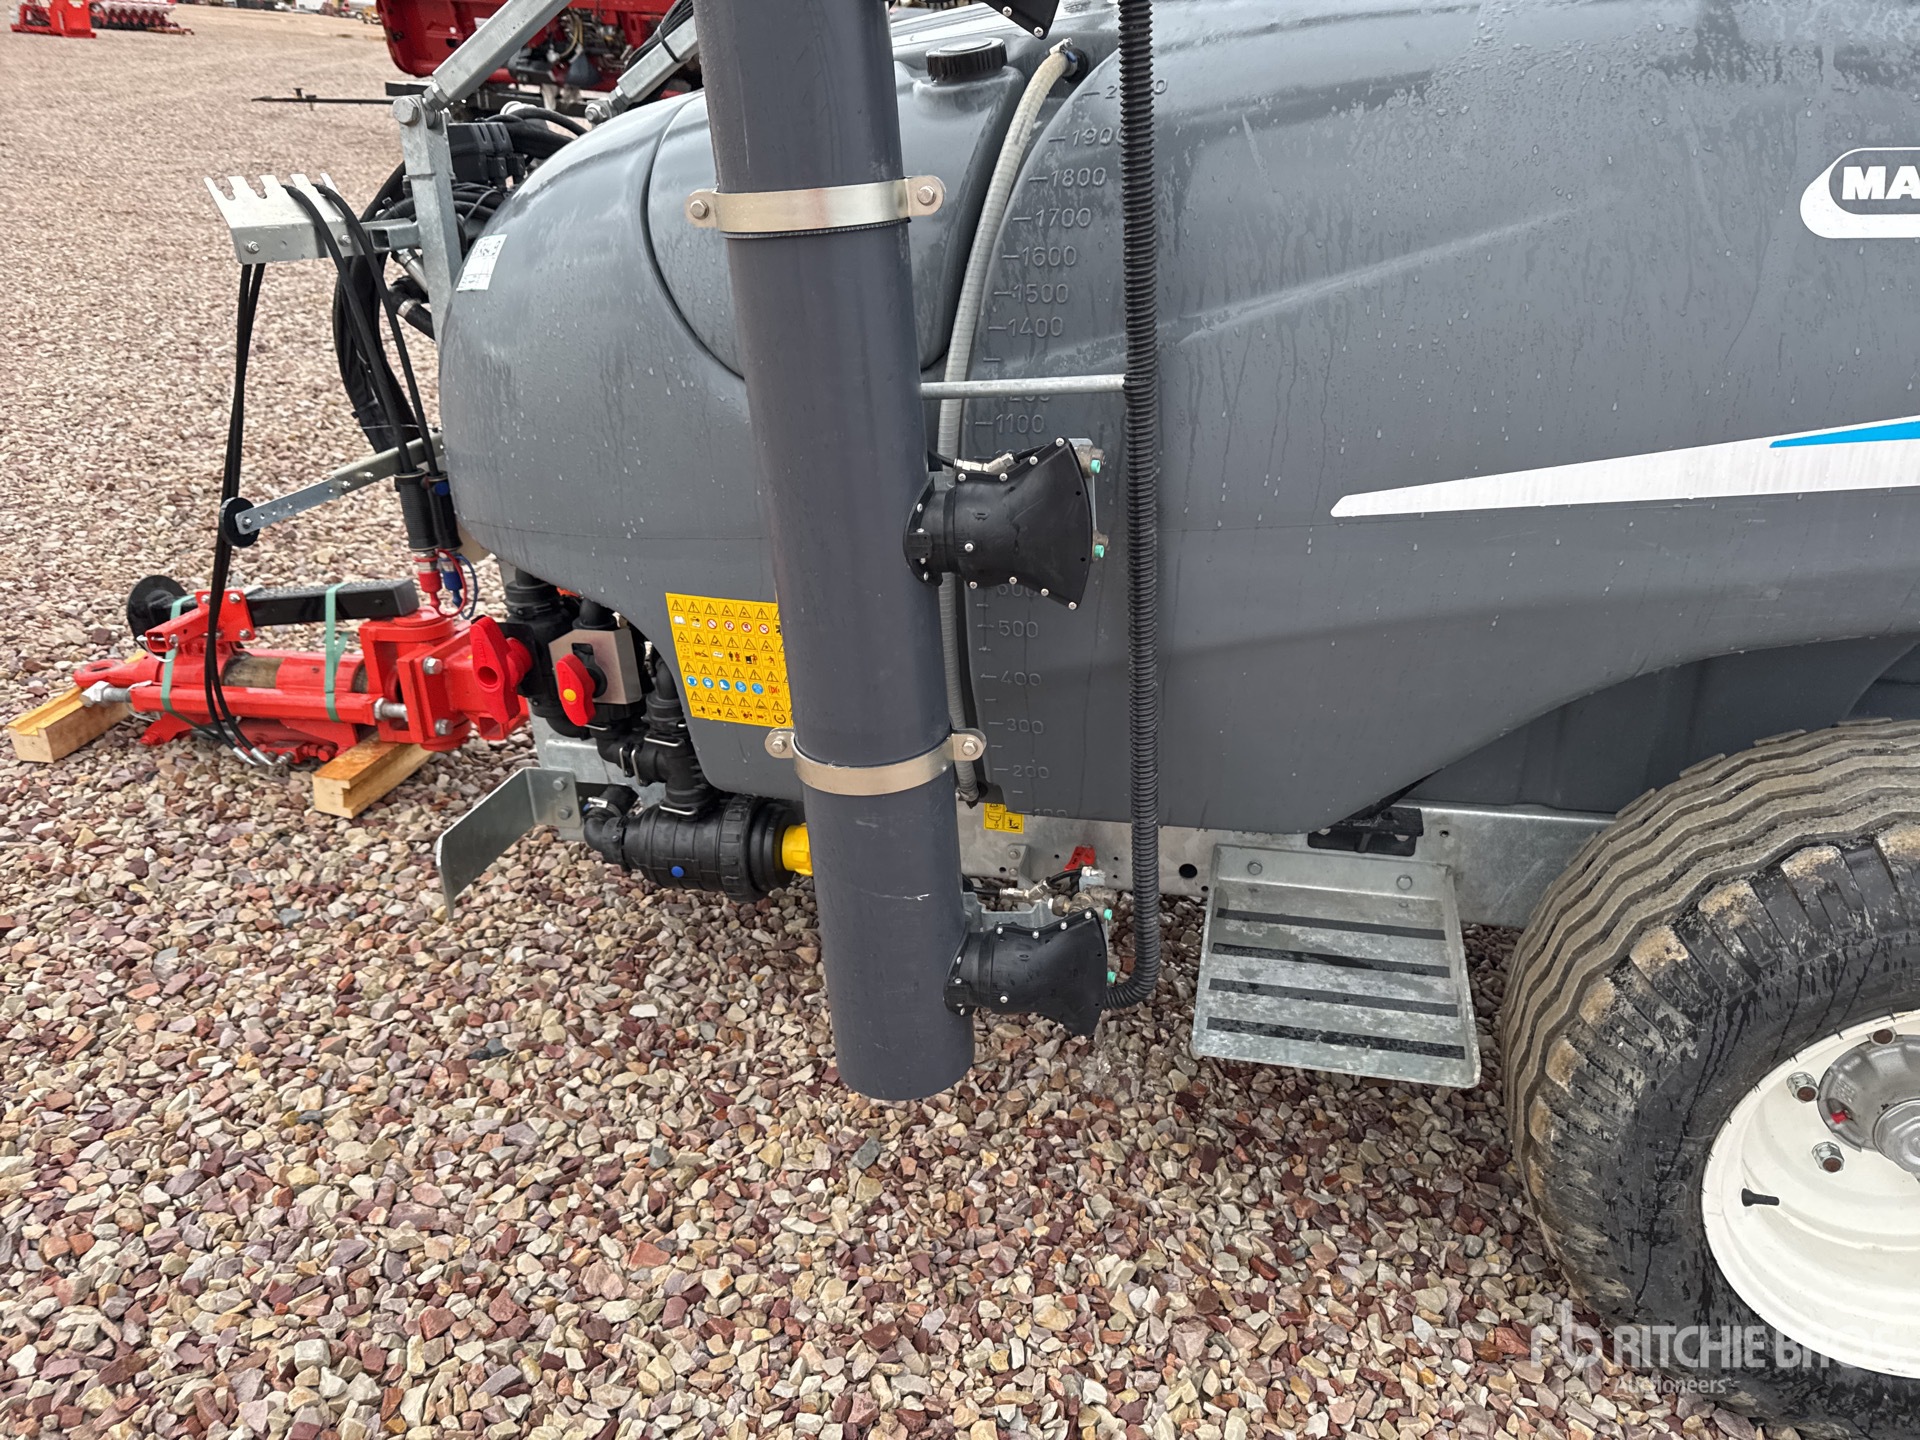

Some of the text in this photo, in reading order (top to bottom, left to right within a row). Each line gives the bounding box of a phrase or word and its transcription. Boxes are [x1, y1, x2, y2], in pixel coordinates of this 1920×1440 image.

[1105, 78, 1168, 100] 20
[1051, 167, 1107, 187] 1800
[1035, 207, 1092, 228] 1700
[1022, 245, 1078, 267] 1600
[1013, 283, 1069, 304] 1500
[1008, 316, 1063, 337] 1400
[995, 413, 1044, 433] 1100
[998, 620, 1039, 638] 500
[1001, 670, 1042, 686] 400
[1006, 718, 1044, 734] 300
[1013, 764, 1049, 779] 200
